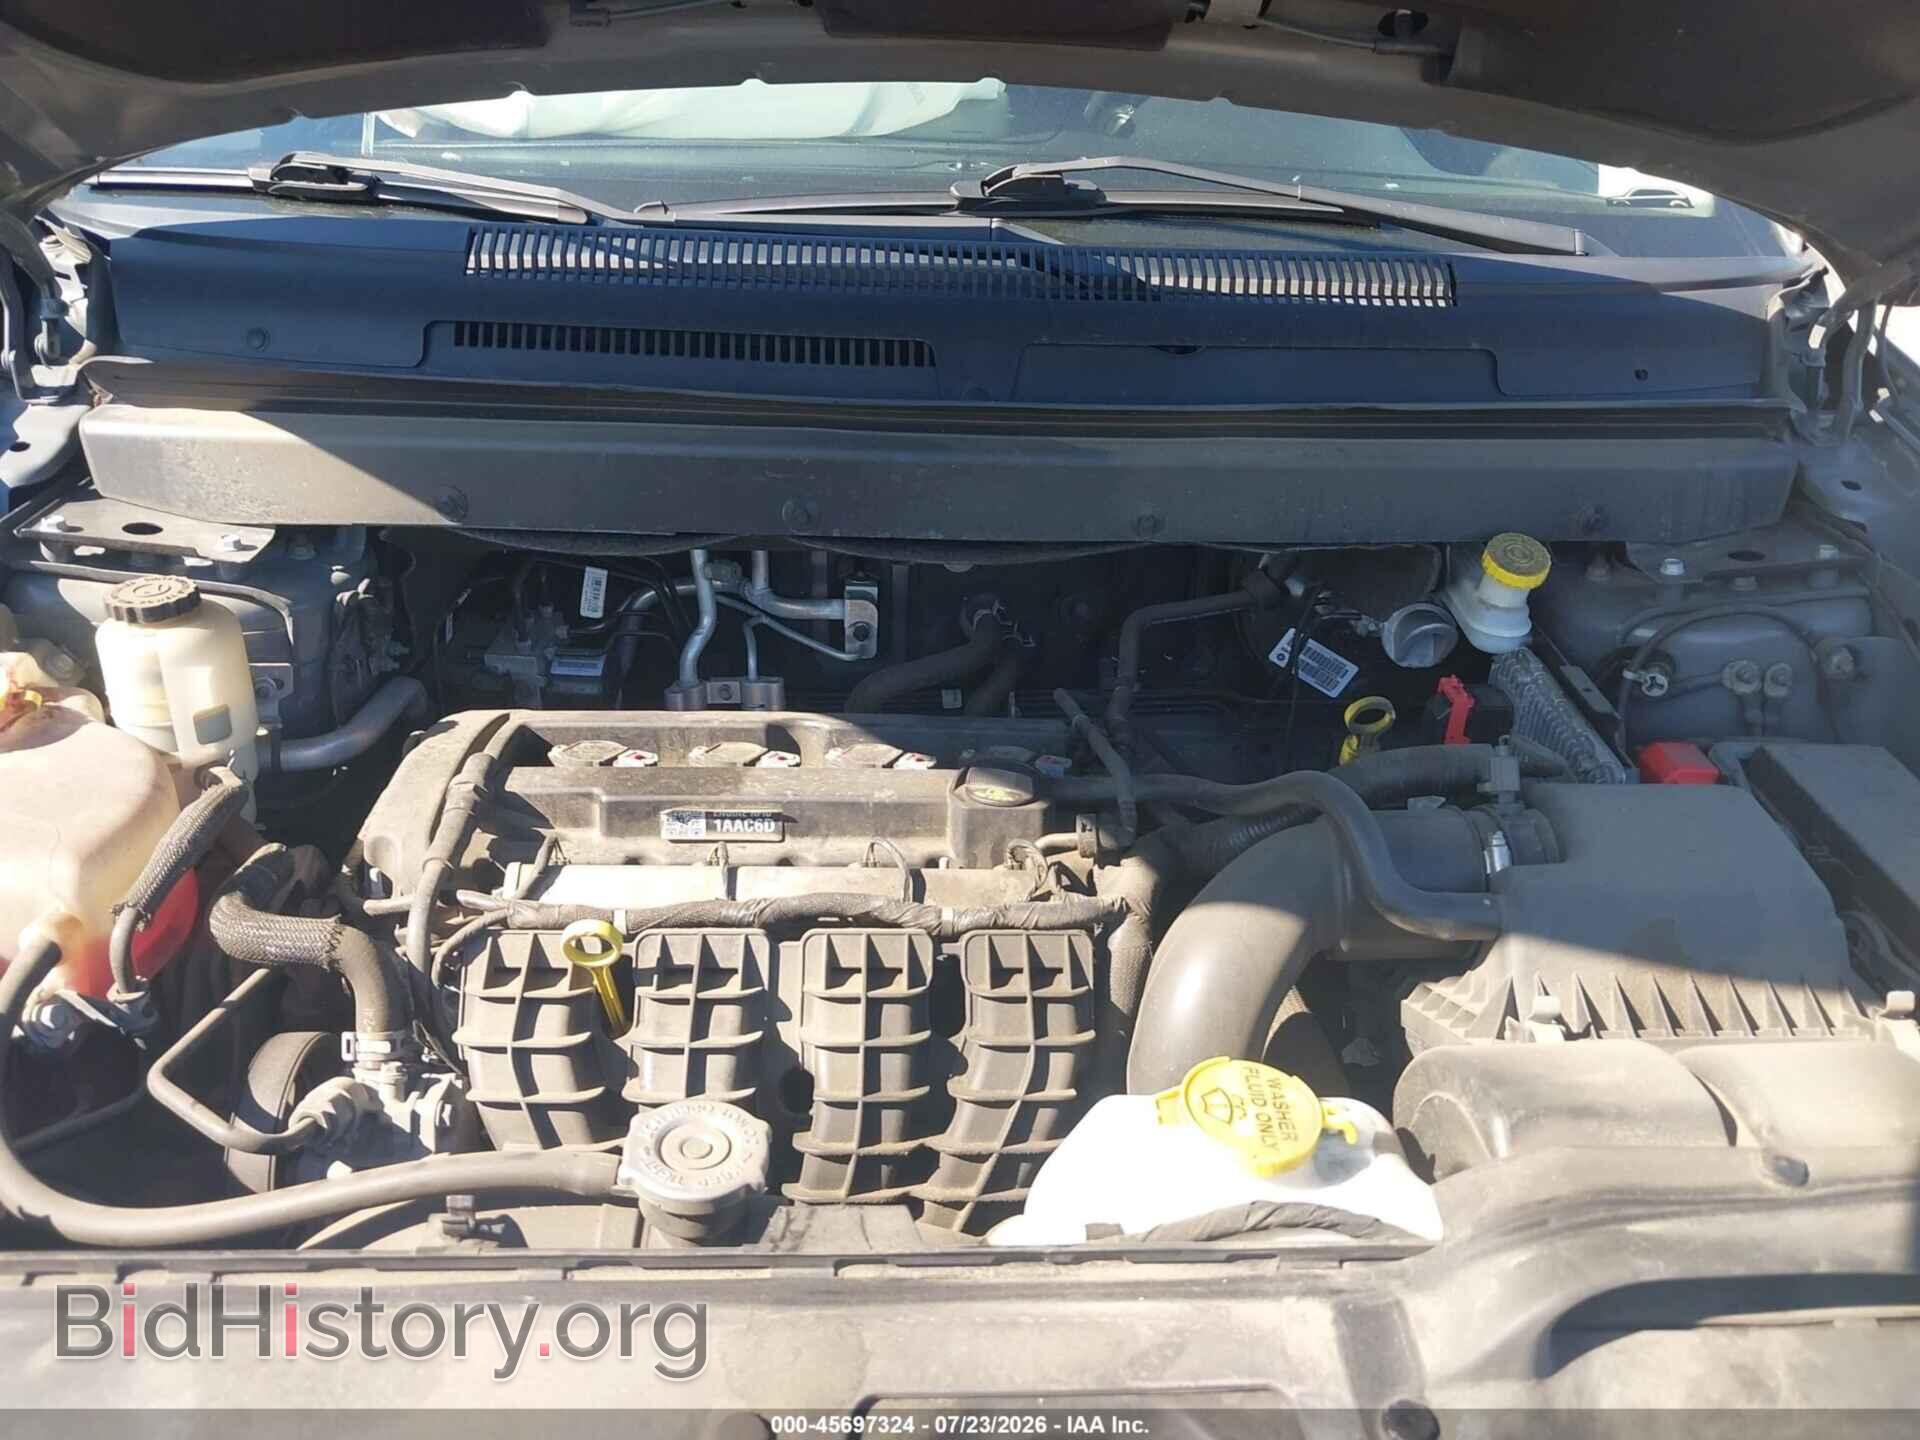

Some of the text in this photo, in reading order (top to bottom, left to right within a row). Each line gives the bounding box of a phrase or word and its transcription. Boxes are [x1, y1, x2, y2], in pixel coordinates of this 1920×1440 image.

[1242, 1066, 1280, 1151] FLUID ONLY
[1266, 1077, 1298, 1143] WASHER
